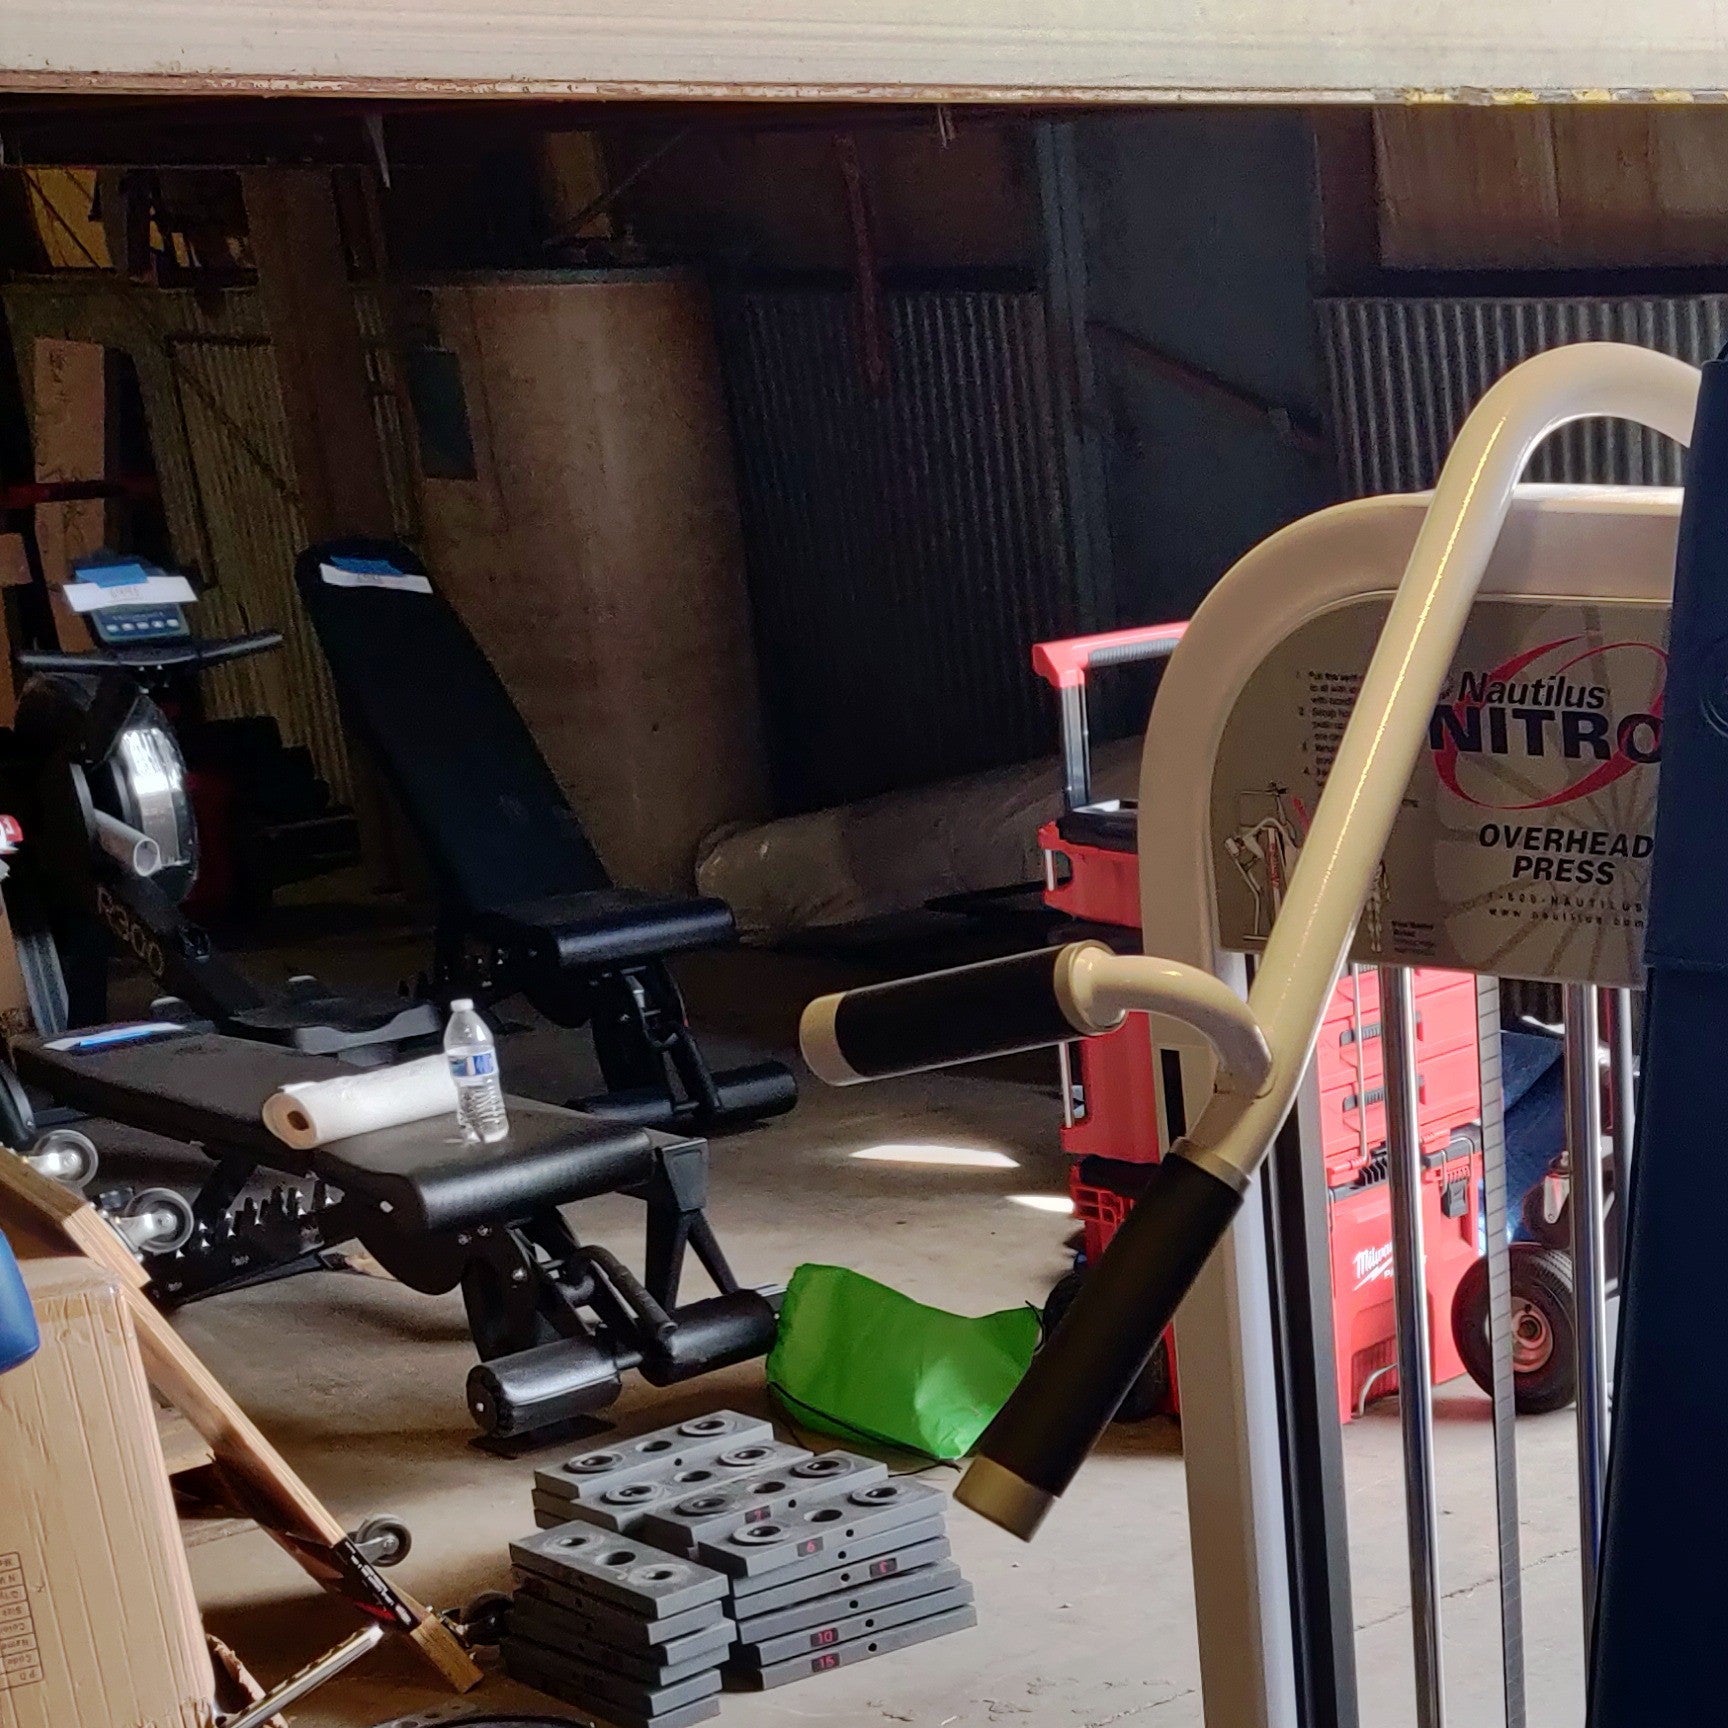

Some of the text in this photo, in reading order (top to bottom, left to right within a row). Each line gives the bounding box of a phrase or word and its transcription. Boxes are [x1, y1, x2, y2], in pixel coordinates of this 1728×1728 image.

[1457, 671, 1607, 709] Nautilus
[1428, 704, 1664, 764] NITRO
[1478, 823, 1655, 859] OVERHEAD
[1511, 855, 1616, 886] PRESS
